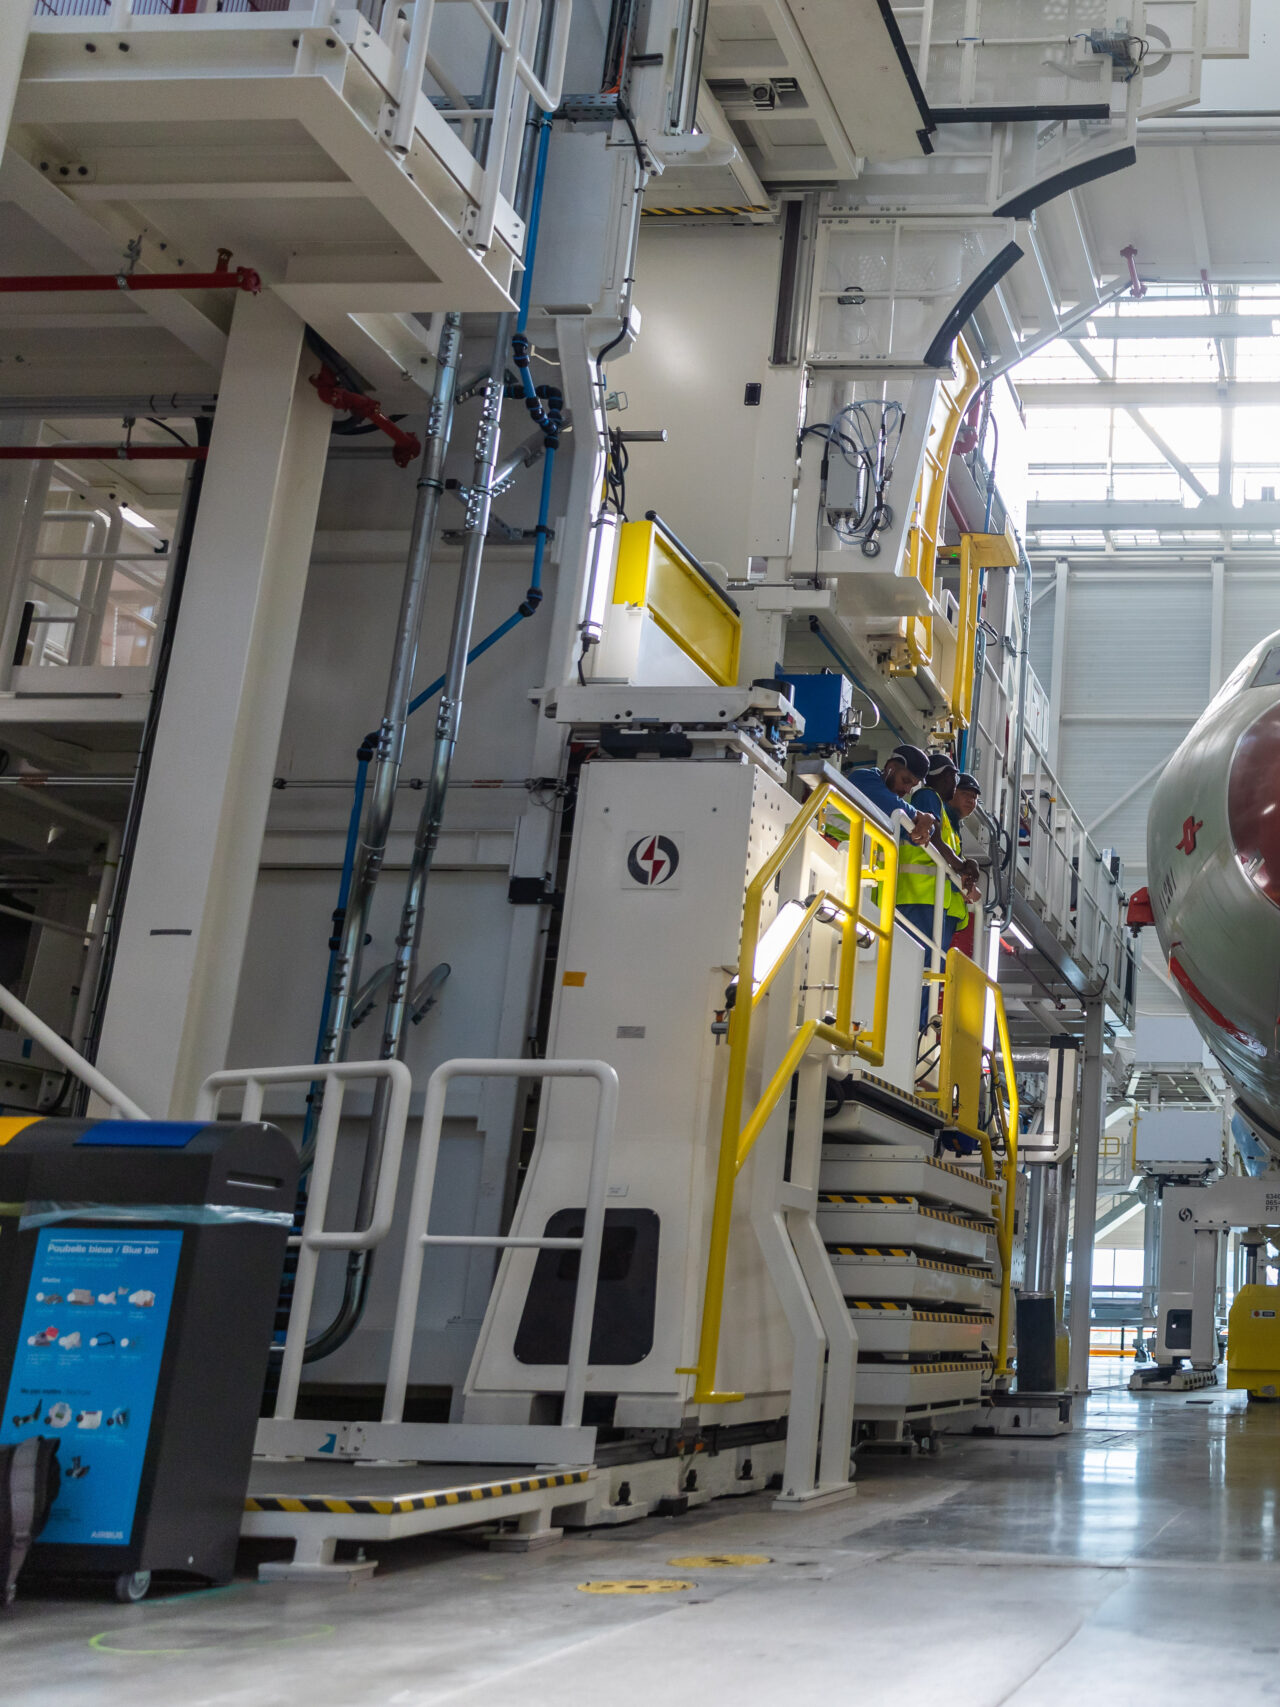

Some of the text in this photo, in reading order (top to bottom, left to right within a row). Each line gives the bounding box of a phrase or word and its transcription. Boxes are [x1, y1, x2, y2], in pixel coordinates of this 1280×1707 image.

[47, 1243, 86, 1253] Poubelle
[88, 1244, 113, 1254] bleue
[122, 1244, 142, 1254] Blue
[144, 1244, 159, 1255] bin
